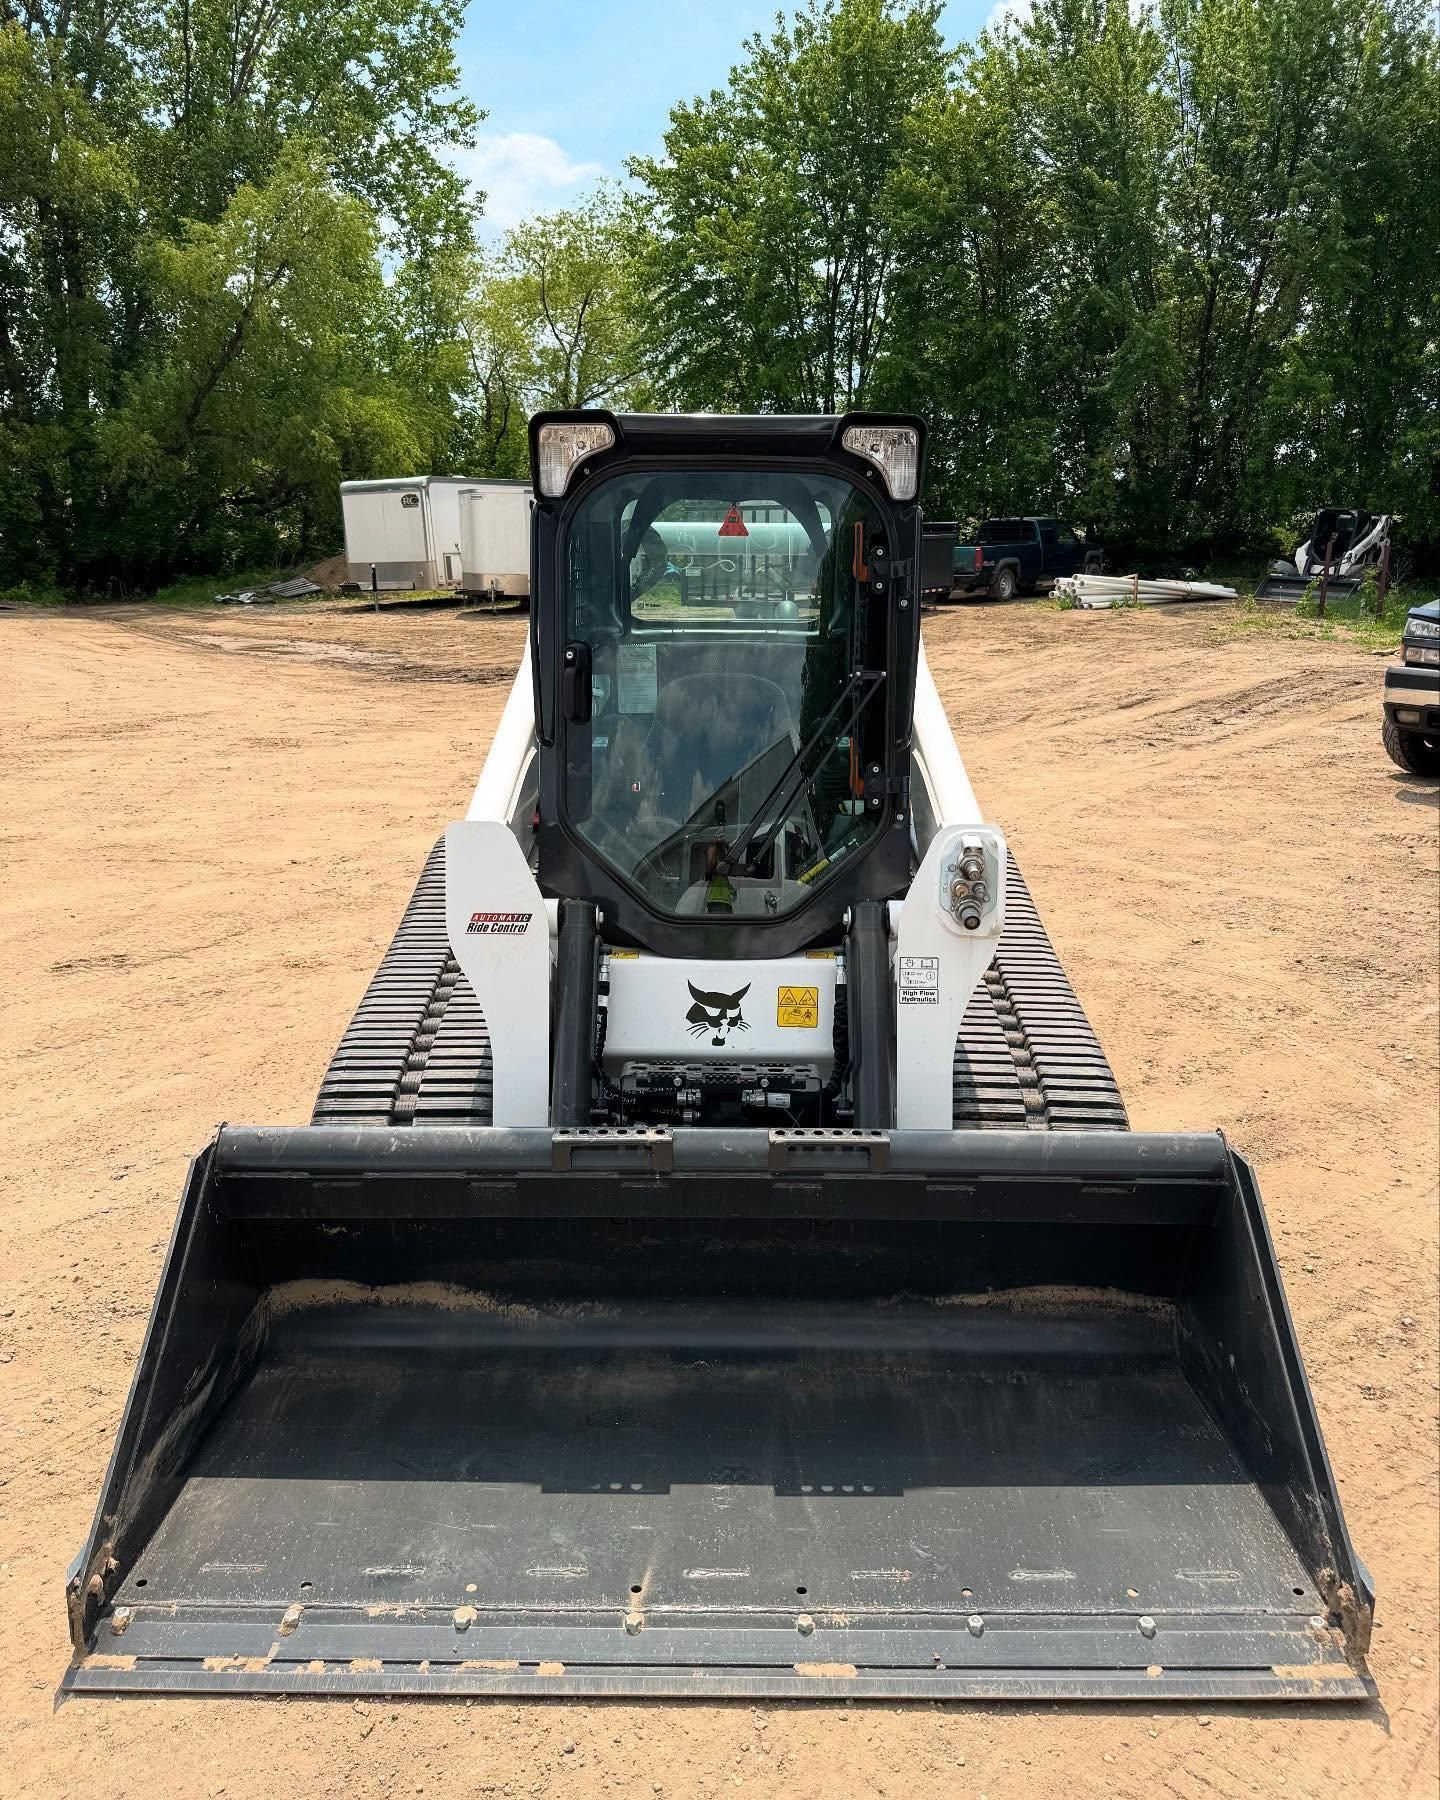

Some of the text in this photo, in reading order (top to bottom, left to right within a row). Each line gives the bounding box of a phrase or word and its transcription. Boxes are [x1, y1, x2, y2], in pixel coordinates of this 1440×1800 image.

[473, 914, 529, 922] AUTOMATIC
[467, 922, 528, 933] Ride Control
